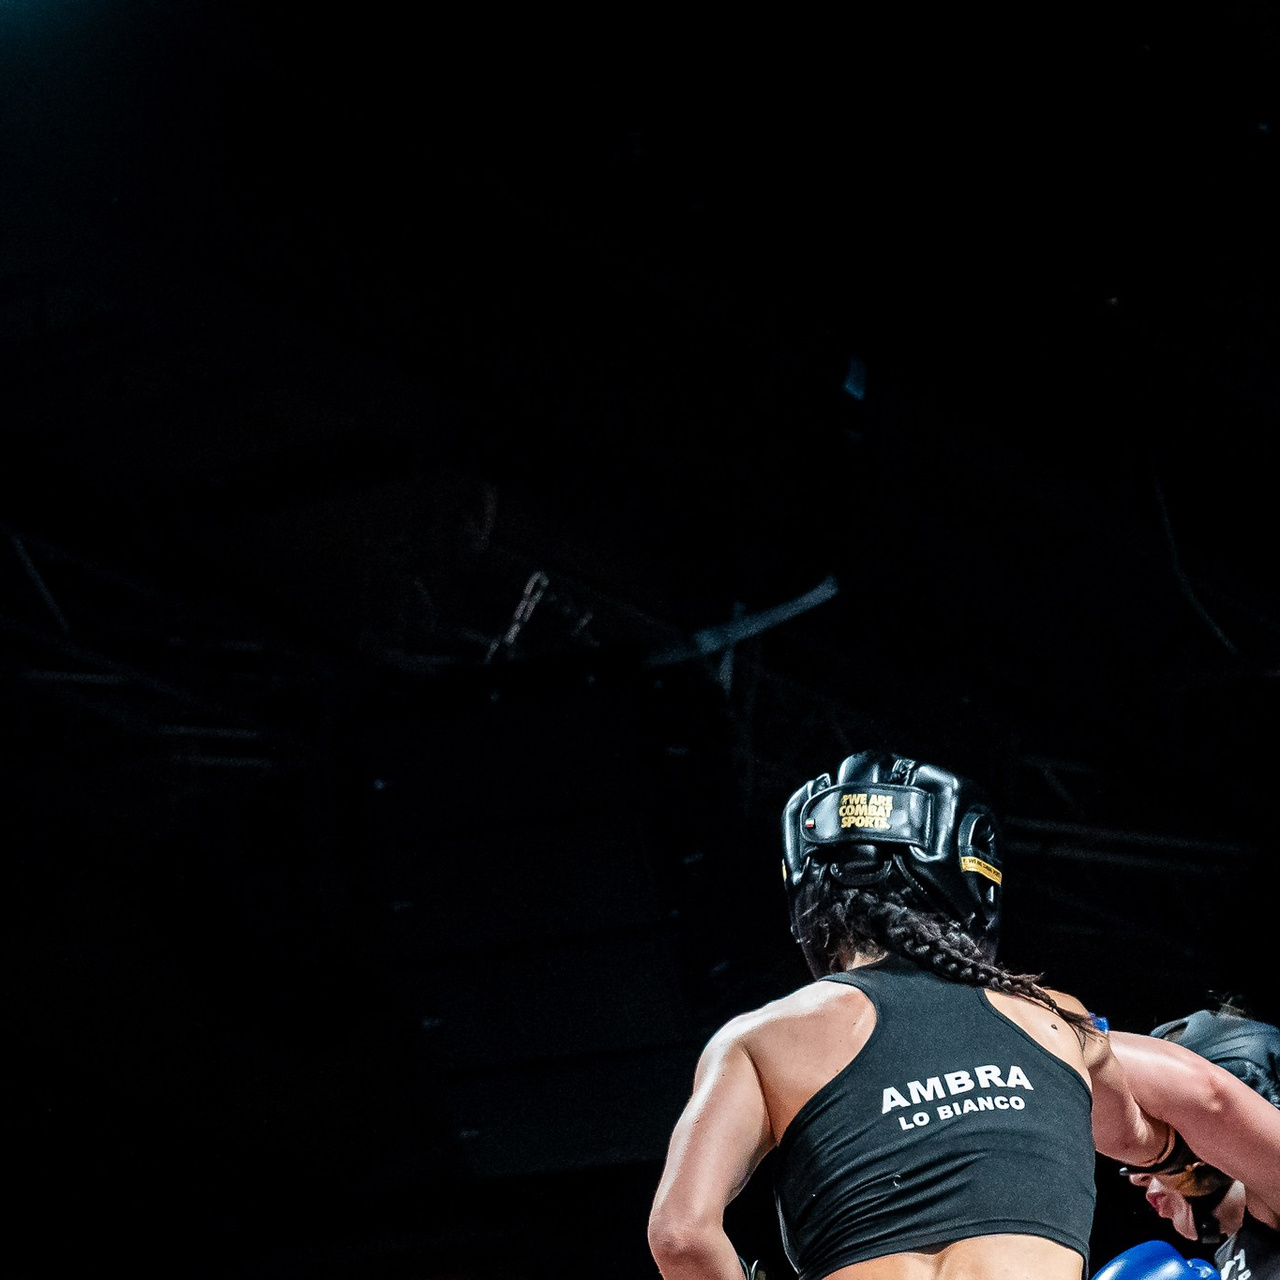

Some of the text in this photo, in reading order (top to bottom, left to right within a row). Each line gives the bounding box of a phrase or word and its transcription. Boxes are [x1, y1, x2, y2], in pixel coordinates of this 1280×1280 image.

[838, 804, 893, 818] COMBAT
[881, 1064, 1034, 1115] AMBRA
[898, 1095, 1026, 1131] LO BIANCO
